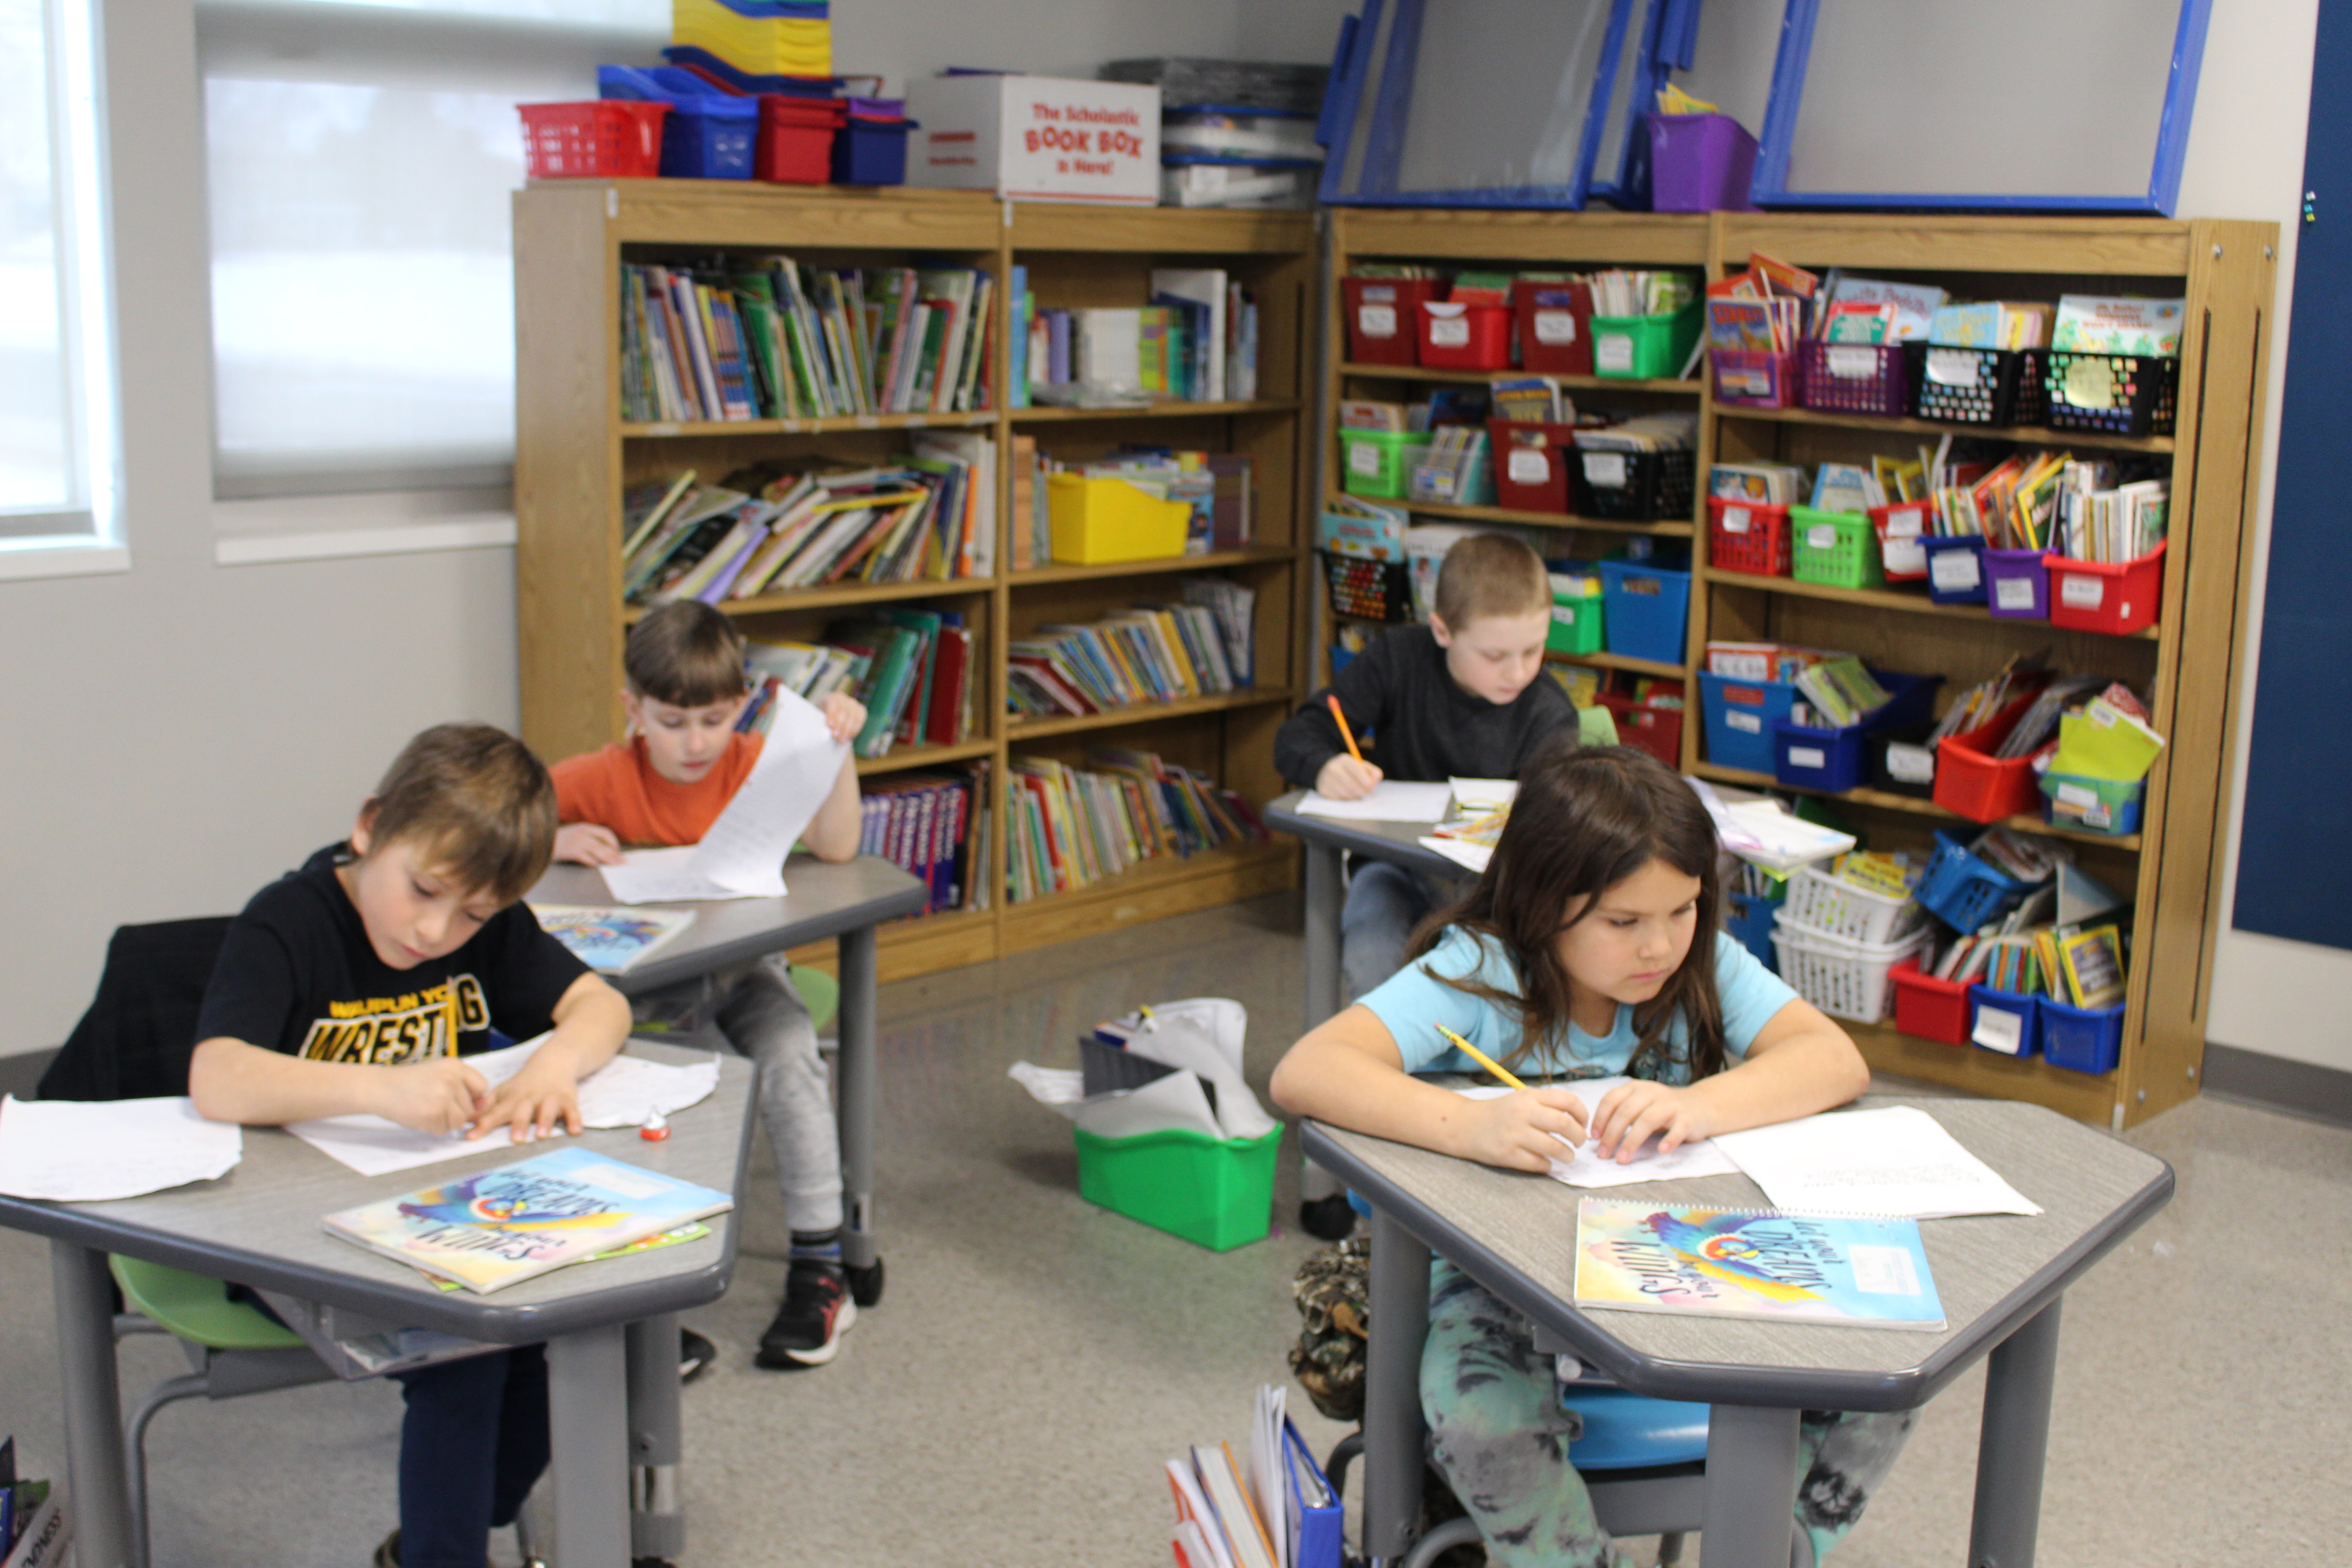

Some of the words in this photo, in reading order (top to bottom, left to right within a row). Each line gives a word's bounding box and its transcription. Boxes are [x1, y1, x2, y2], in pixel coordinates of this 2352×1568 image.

[1033, 103, 1060, 121] The
[1065, 106, 1139, 125] Scholastic
[1025, 126, 1091, 153] BOOK
[1098, 130, 1143, 158] BOX
[480, 1180, 621, 1215] DREAMS
[416, 1224, 544, 1260] WINGS
[1740, 1230, 1832, 1289] DREAMS
[1611, 1240, 1690, 1295] WINGS
